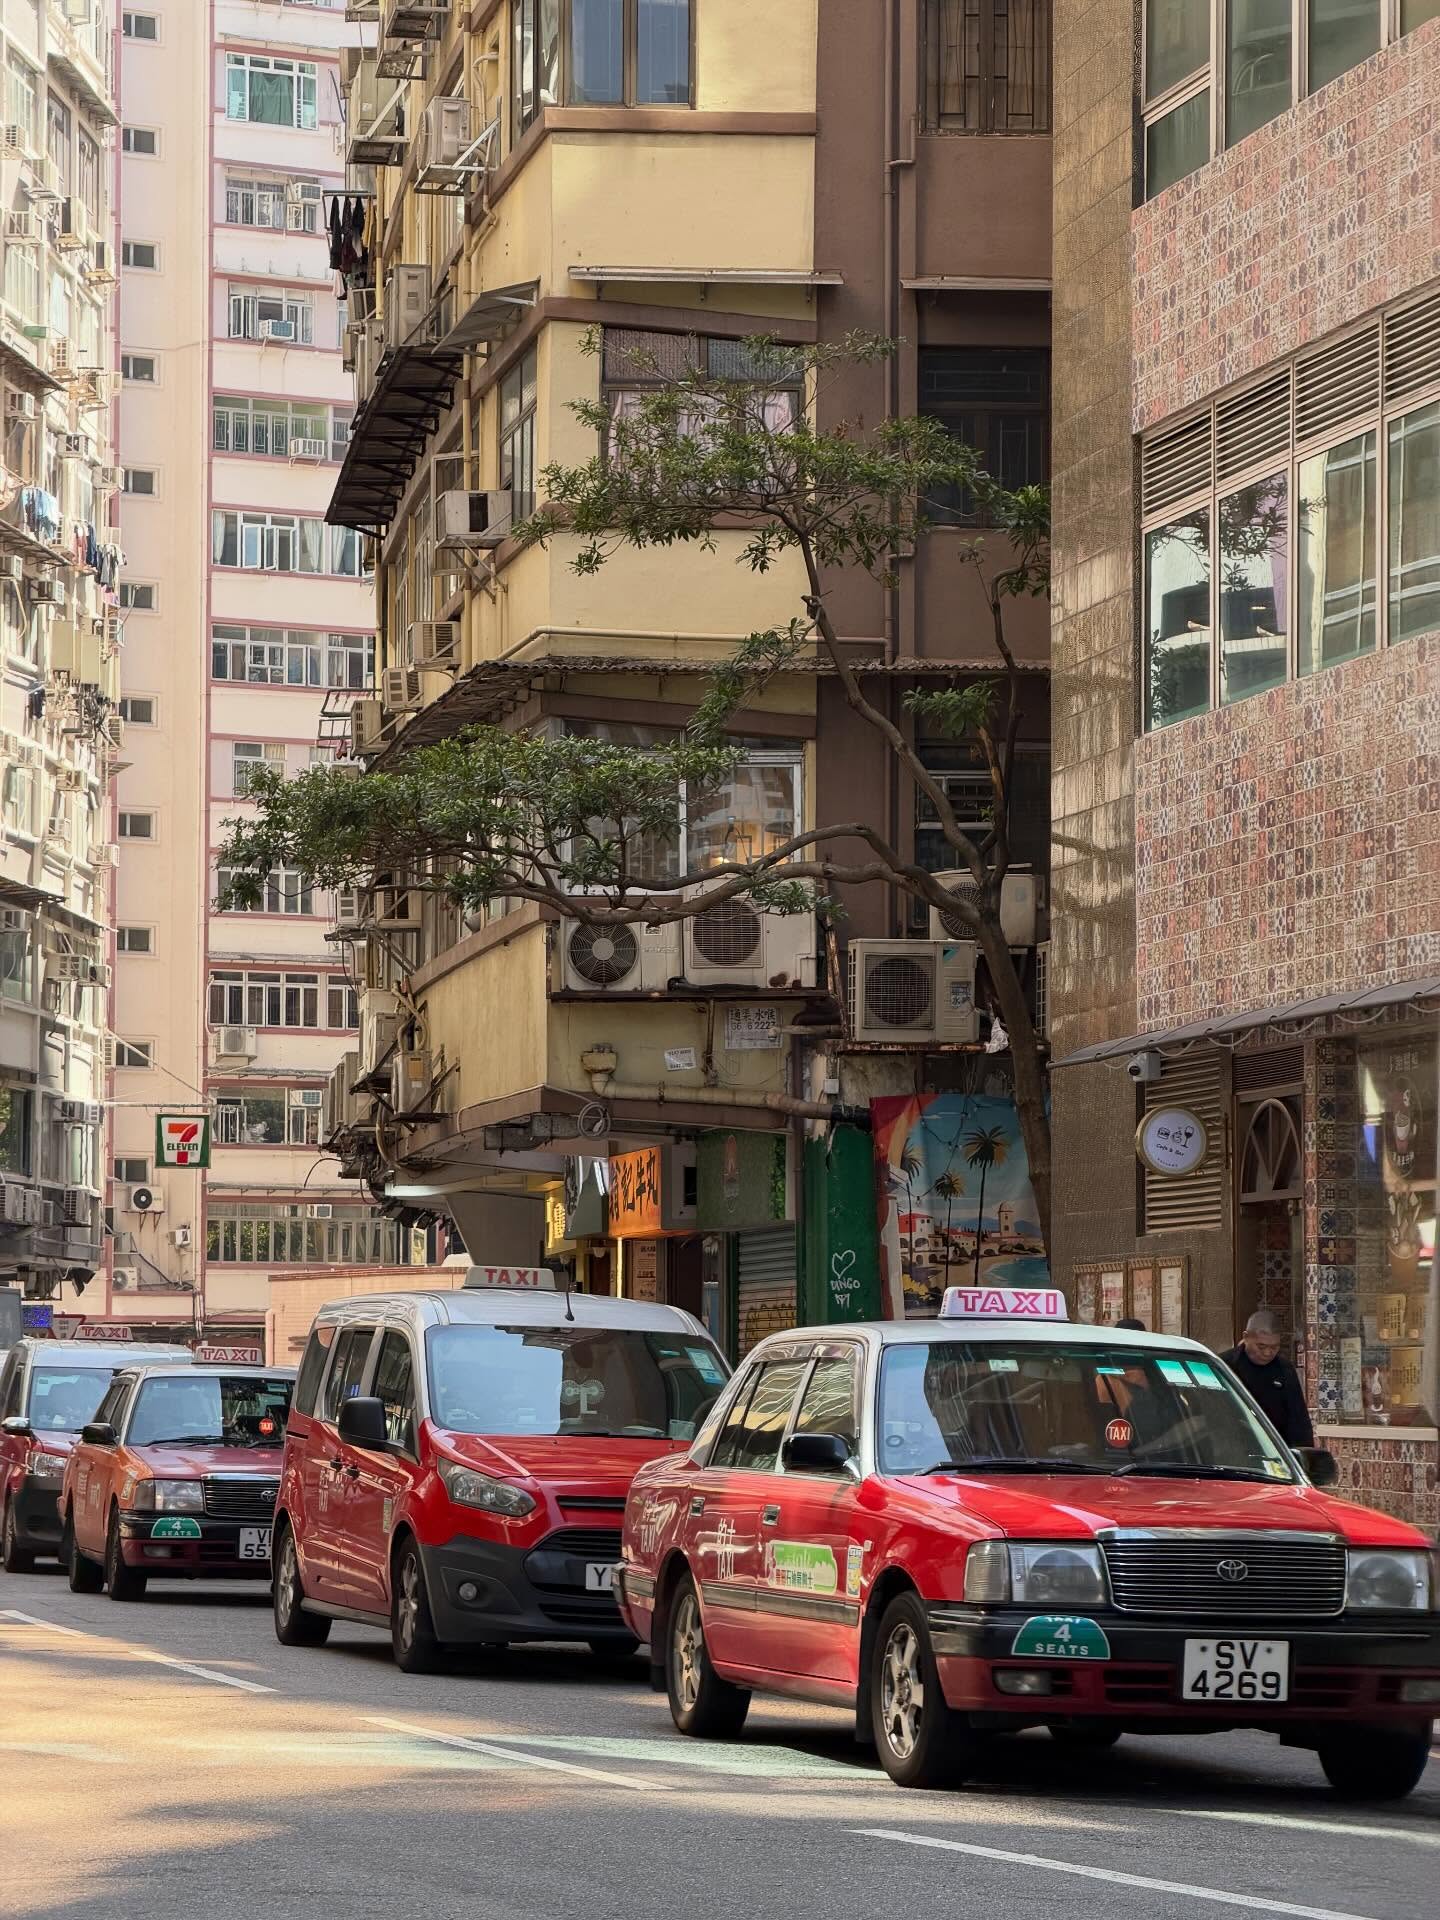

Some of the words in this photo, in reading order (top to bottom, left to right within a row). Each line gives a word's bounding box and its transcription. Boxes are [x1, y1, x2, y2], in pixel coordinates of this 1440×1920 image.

[167, 1122, 198, 1164] 7
[484, 1268, 539, 1286] TAXI
[958, 1289, 1058, 1315] TAXI
[81, 1326, 128, 1339] TAXI
[201, 1347, 258, 1362] TAXI
[1108, 1426, 1131, 1441] TAXI
[171, 1520, 182, 1531] 4
[257, 1529, 272, 1543] V
[244, 1543, 272, 1557] 55
[593, 1566, 613, 1587] Y
[1053, 1623, 1073, 1642] 4
[1035, 1643, 1089, 1656] SEATS
[1215, 1641, 1258, 1670] SV
[1190, 1670, 1281, 1699] 4269
